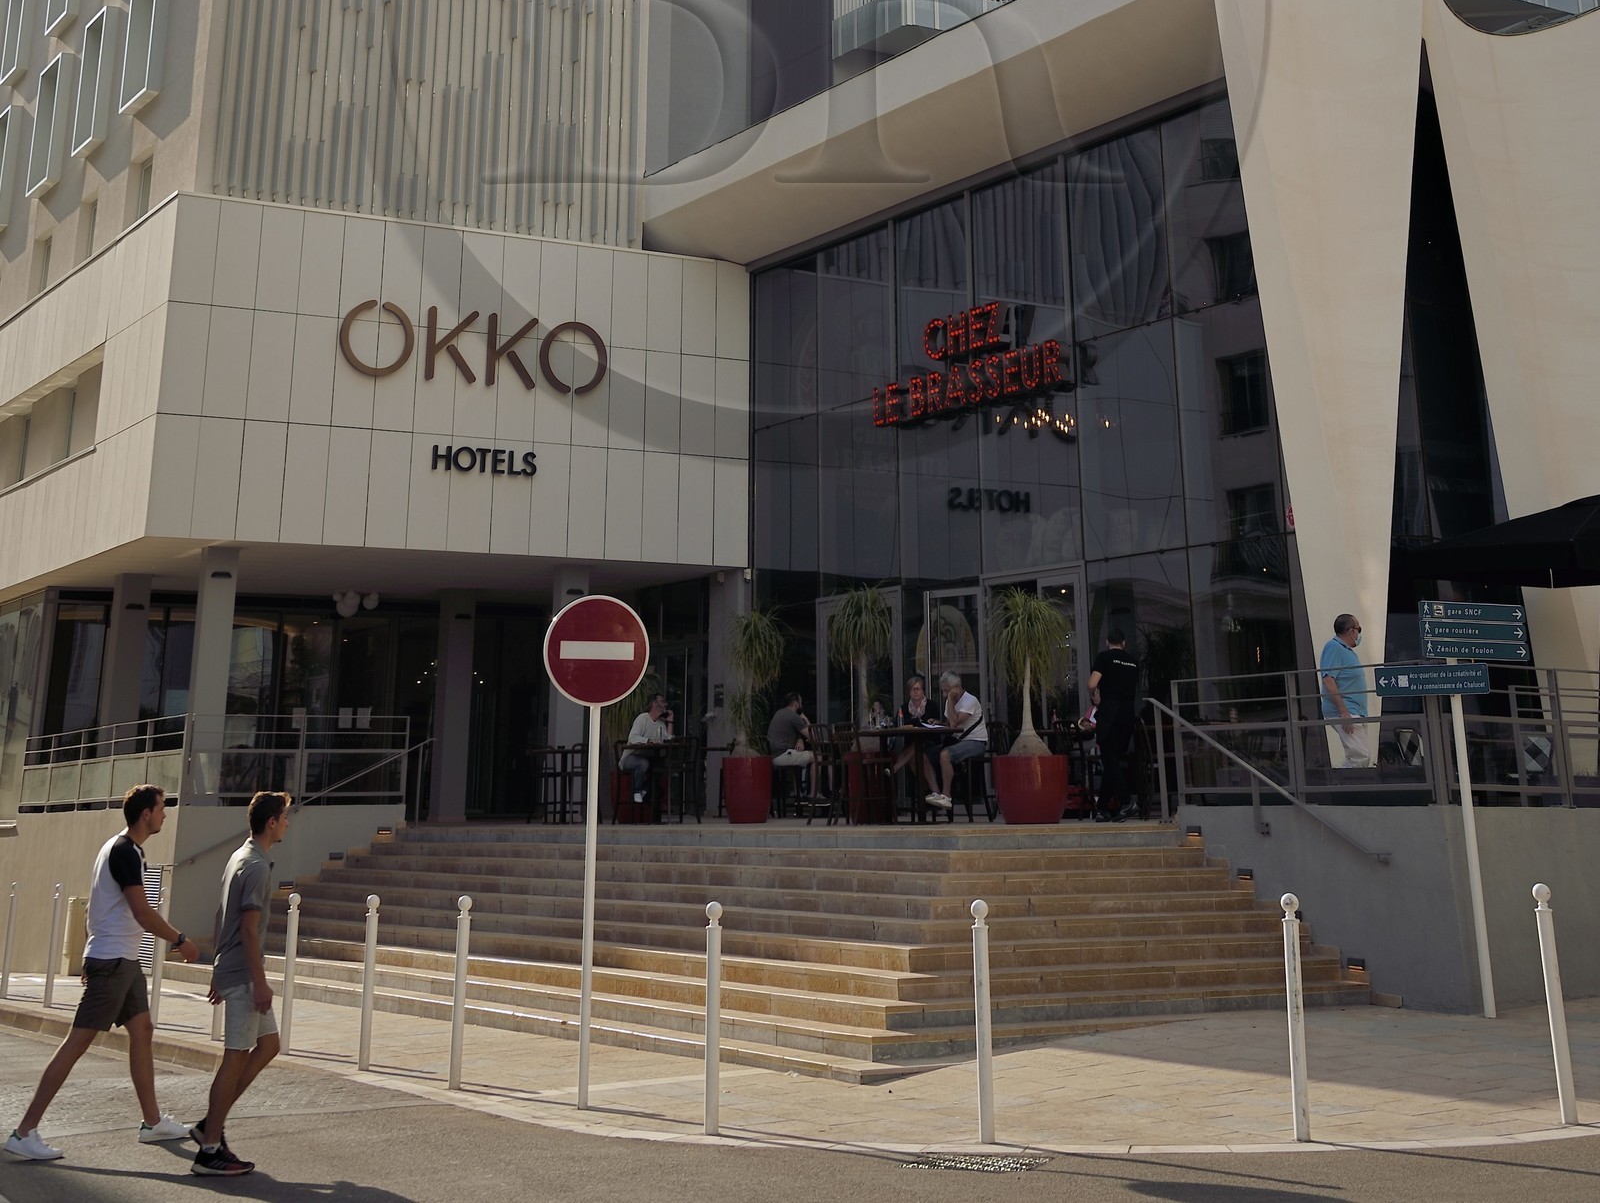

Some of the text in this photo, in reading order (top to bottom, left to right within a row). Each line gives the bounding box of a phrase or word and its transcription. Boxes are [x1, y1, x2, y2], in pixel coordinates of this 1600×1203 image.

[923, 301, 1000, 361] CHEZ
[339, 299, 608, 395] OKKO
[872, 382, 900, 428] LE
[909, 339, 1063, 418] BRASSEUR
[431, 444, 538, 477] HOTELS
[1447, 608, 1482, 617] gare SNCF
[1434, 627, 1451, 635] gare
[1451, 627, 1480, 635] routière
[1436, 645, 1494, 654] Zénith de Toulon
[1423, 682, 1455, 690] connaissance
